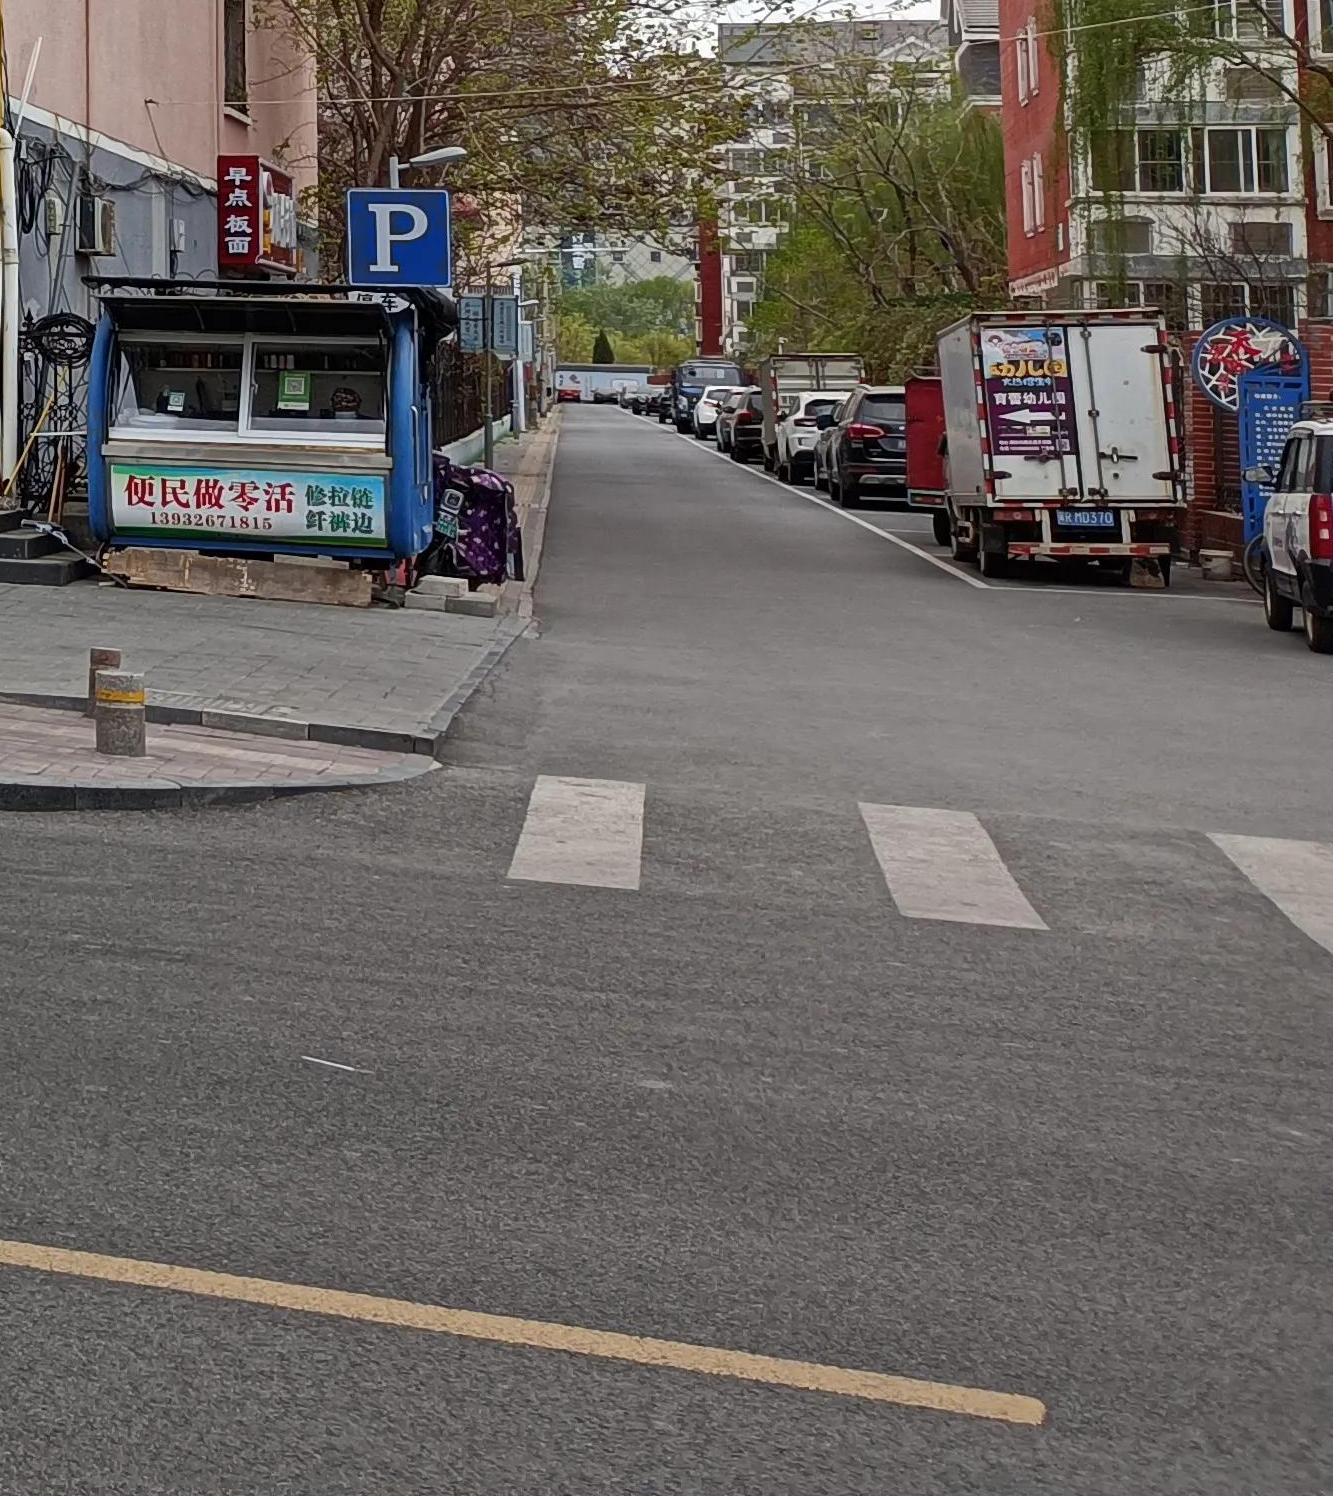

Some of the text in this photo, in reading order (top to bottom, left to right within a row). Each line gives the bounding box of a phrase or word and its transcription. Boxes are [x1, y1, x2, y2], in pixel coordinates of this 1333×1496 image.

[224, 167, 252, 254] 早点板面
[368, 204, 428, 272] P
[124, 474, 295, 514] 便民做零活
[305, 484, 374, 510] 修拉链
[150, 511, 272, 530] 13932671815
